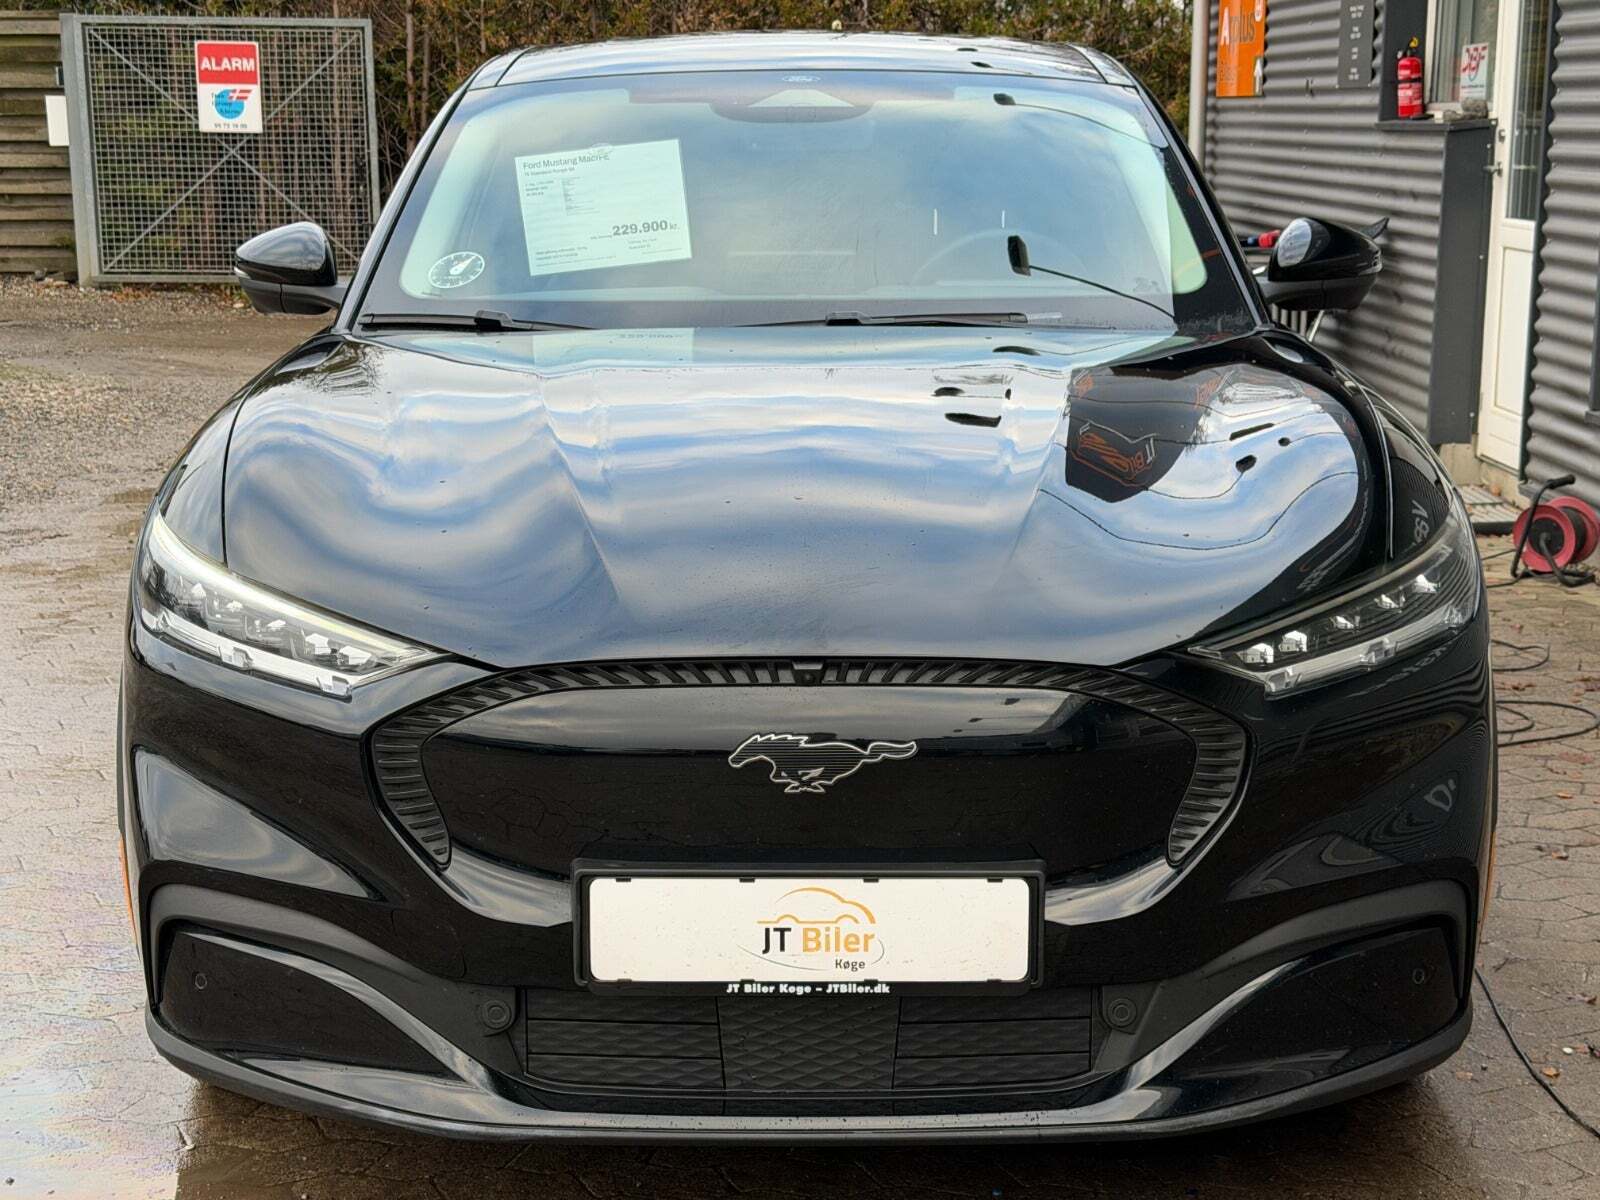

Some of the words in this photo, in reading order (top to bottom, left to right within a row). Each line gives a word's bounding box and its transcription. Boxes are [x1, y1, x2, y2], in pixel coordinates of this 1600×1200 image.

[201, 56, 255, 72] ALARM
[523, 162, 541, 170] Ford
[542, 158, 578, 168] Mustang
[612, 220, 668, 236] 229.900
[762, 927, 792, 955] JT
[802, 926, 875, 953] Biler
[835, 958, 866, 972] Køge
[726, 984, 740, 993] JT
[744, 984, 775, 993] Biler
[826, 984, 890, 993] JTBiler.dk
